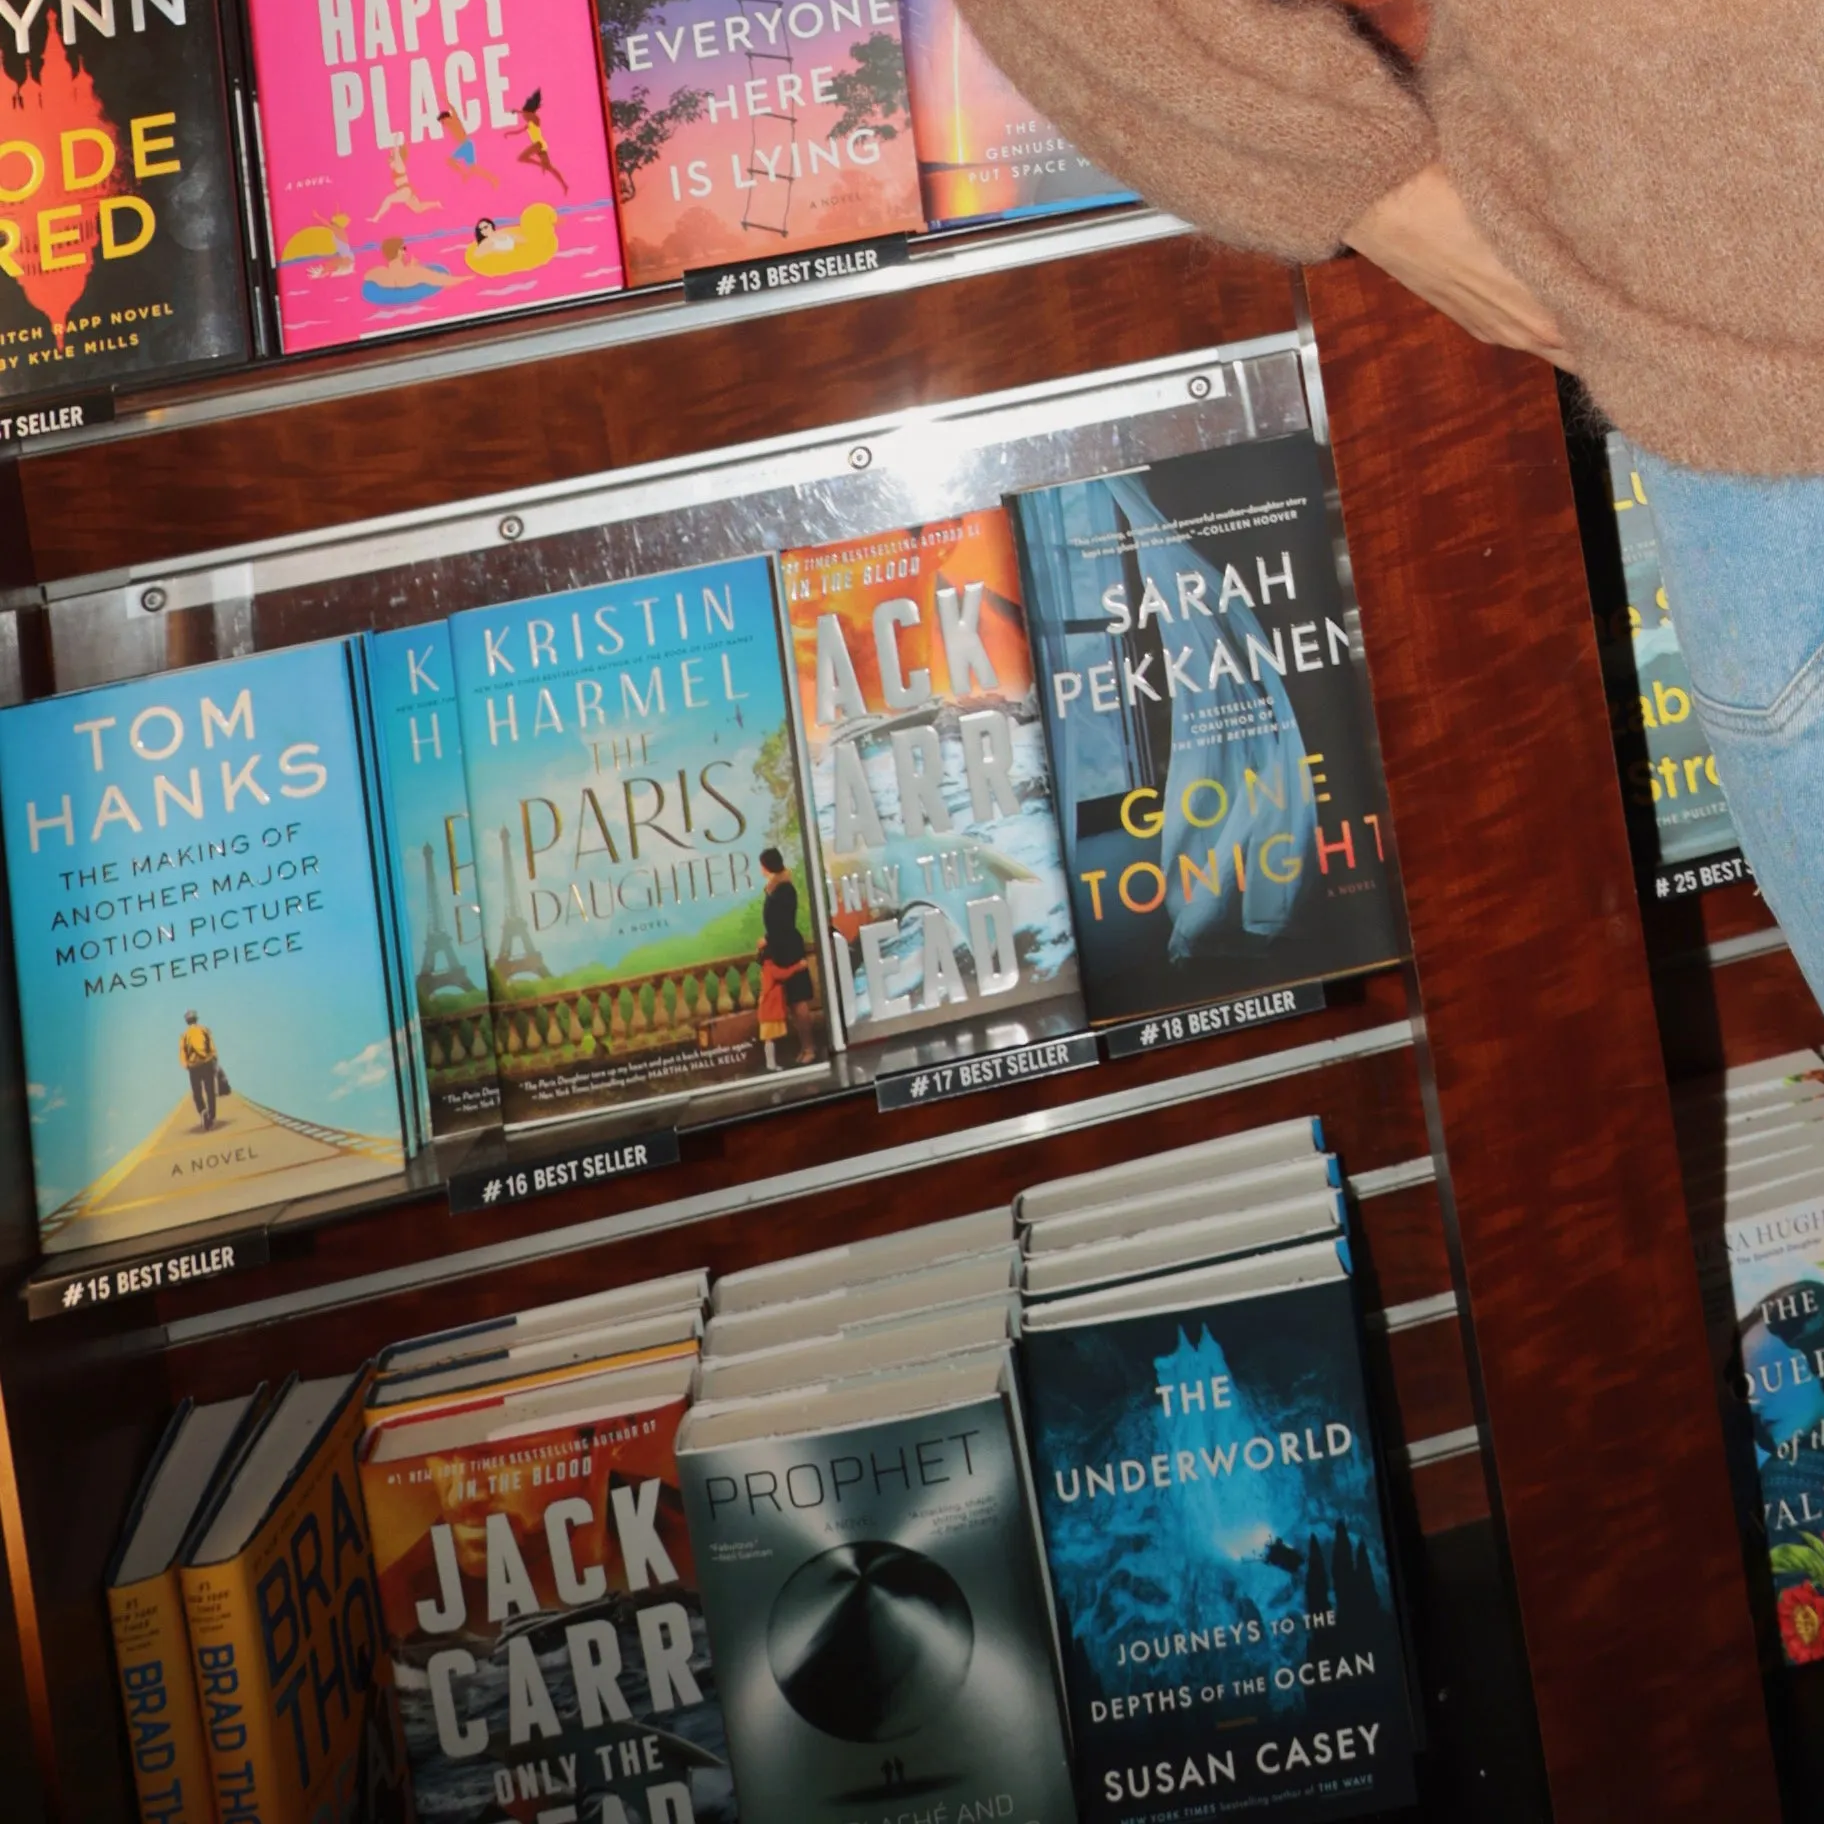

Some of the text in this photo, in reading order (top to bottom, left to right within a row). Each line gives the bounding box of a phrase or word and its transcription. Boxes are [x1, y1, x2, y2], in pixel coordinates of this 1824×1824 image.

[331, 43, 518, 157] PLACE
[707, 69, 838, 124] HERE
[671, 128, 881, 203] IS LYING
[715, 249, 878, 296] #13 BEST SELLER
[481, 586, 740, 680] KRISTIN
[1100, 555, 1297, 638] SARAH
[487, 651, 752, 745] HARMEL
[1055, 617, 1350, 721] PEKKANEN
[75, 690, 256, 770] TOM
[24, 744, 330, 854] HANKS
[521, 760, 751, 886] PARIS
[1117, 751, 1330, 840] GONE
[529, 848, 758, 933] DAUGHTER
[1080, 814, 1389, 921] TONIGHT
[1153, 1374, 1232, 1417] THE
[703, 1430, 982, 1526] PROPHET
[1052, 1421, 1356, 1503] UNDERWORLD
[412, 1478, 680, 1637] JACK
[426, 1604, 706, 1758] CARR
[1102, 1722, 1382, 1805] SUSAN CASEY
